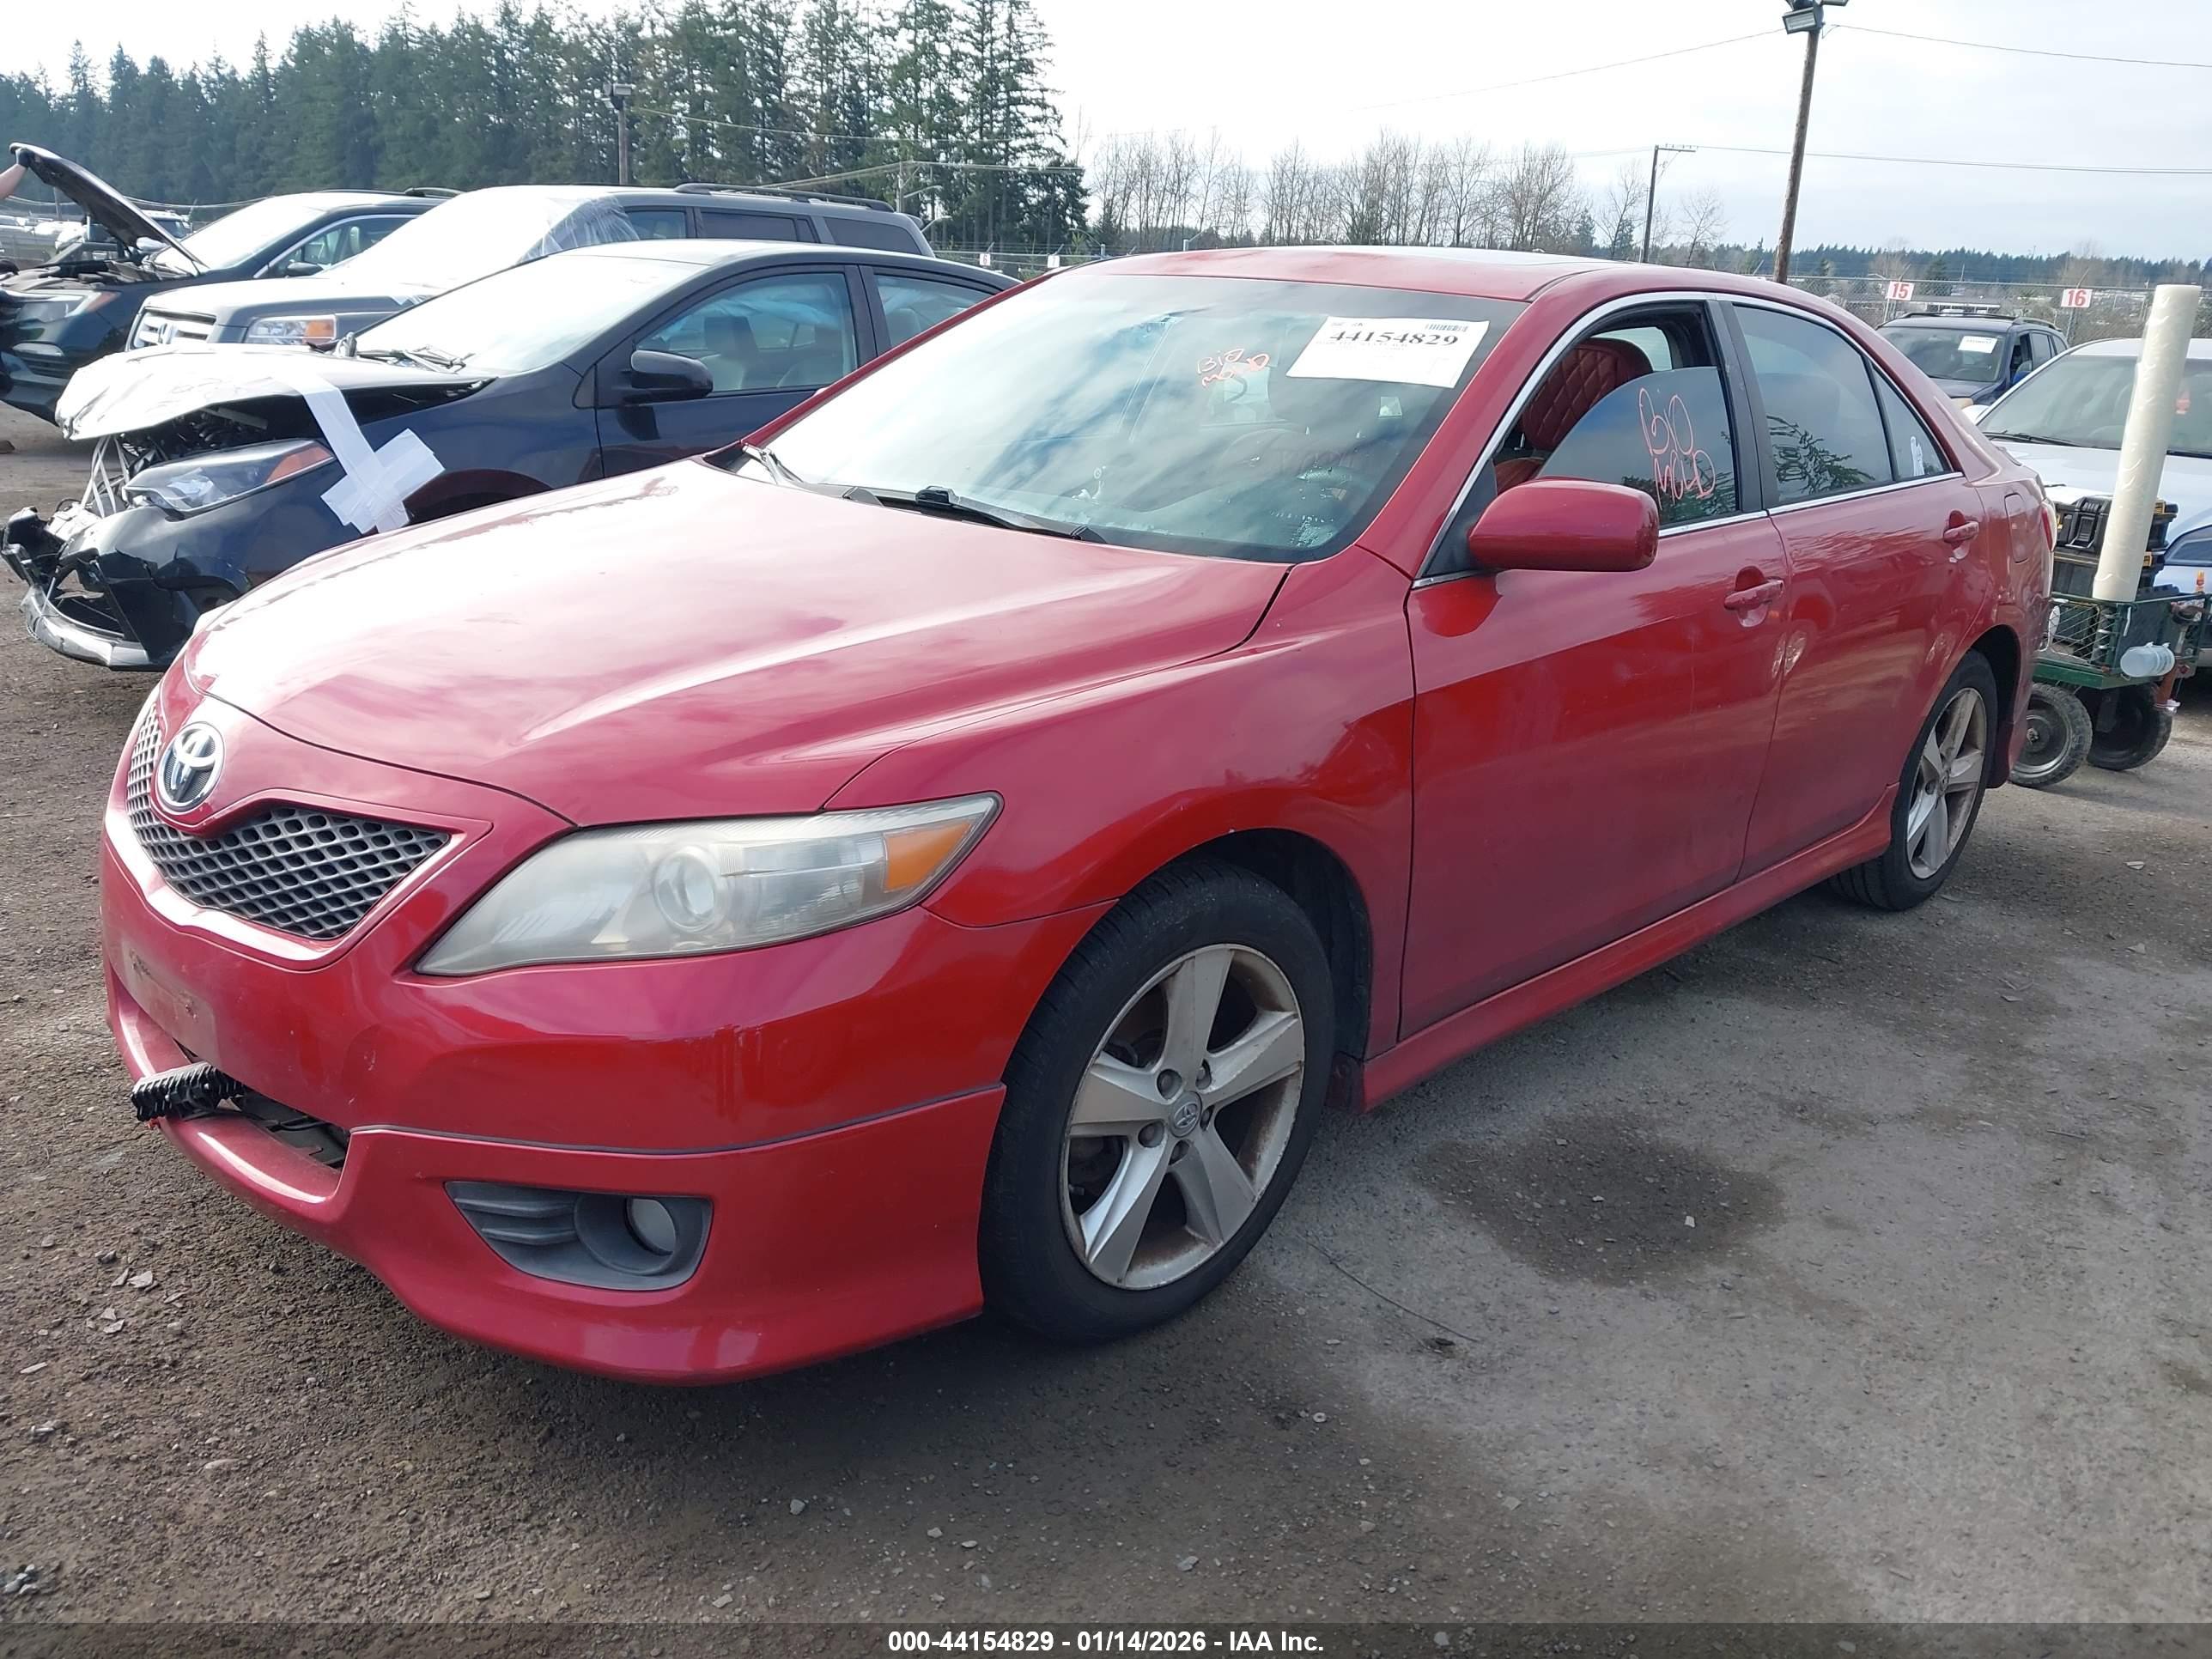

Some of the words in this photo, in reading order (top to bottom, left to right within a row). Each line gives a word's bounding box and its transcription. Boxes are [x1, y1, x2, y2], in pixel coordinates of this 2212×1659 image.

[1892, 283, 1910, 299] 15
[2067, 289, 2087, 307] 16
[1329, 331, 1459, 346] 44154829
